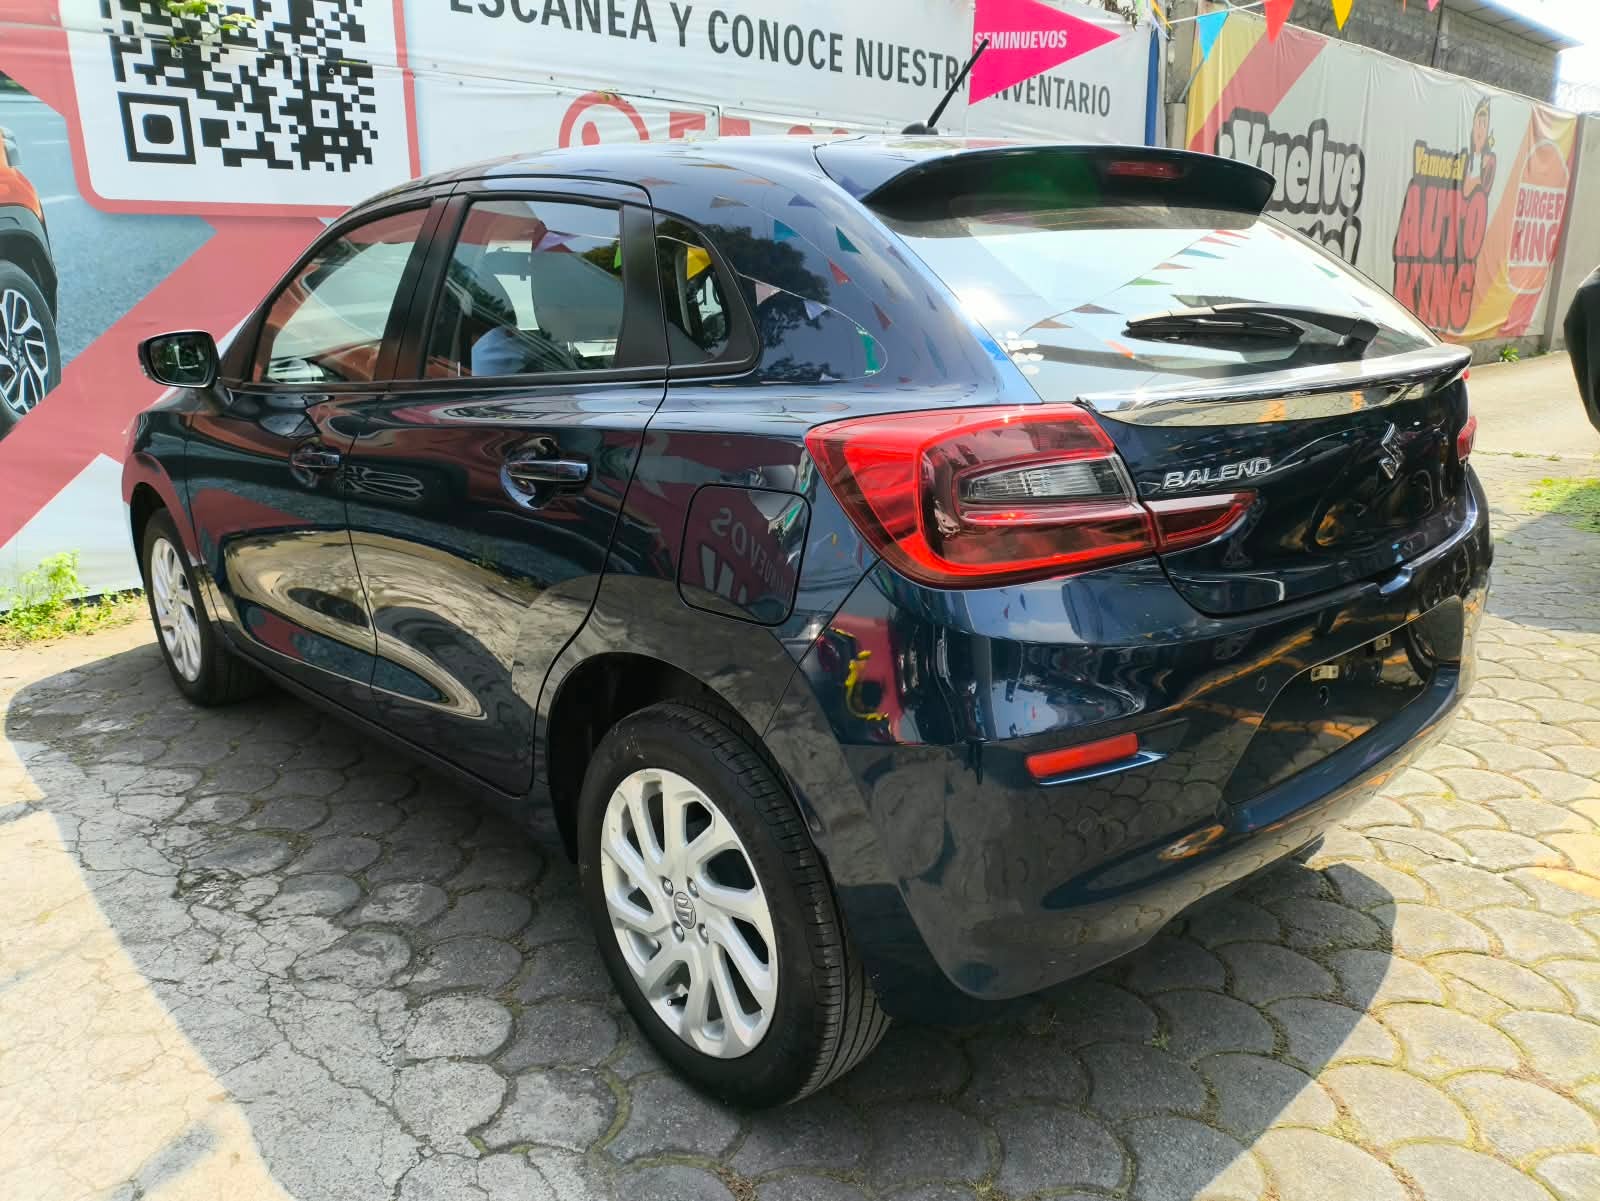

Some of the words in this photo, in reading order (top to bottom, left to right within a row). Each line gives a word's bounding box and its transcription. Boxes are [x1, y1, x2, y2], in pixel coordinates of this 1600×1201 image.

[450, 0, 657, 43] ANEA
[670, 1, 692, 48] Y
[708, 10, 843, 73] CONOCE
[988, 74, 1110, 118] VENTARIO
[974, 30, 1068, 50] SEMINUEVOS
[1395, 183, 1487, 259] AUTO
[1516, 188, 1565, 220] BURGER
[1509, 220, 1560, 265] KING
[1394, 261, 1475, 329] KING
[1162, 457, 1272, 489] BALENO
